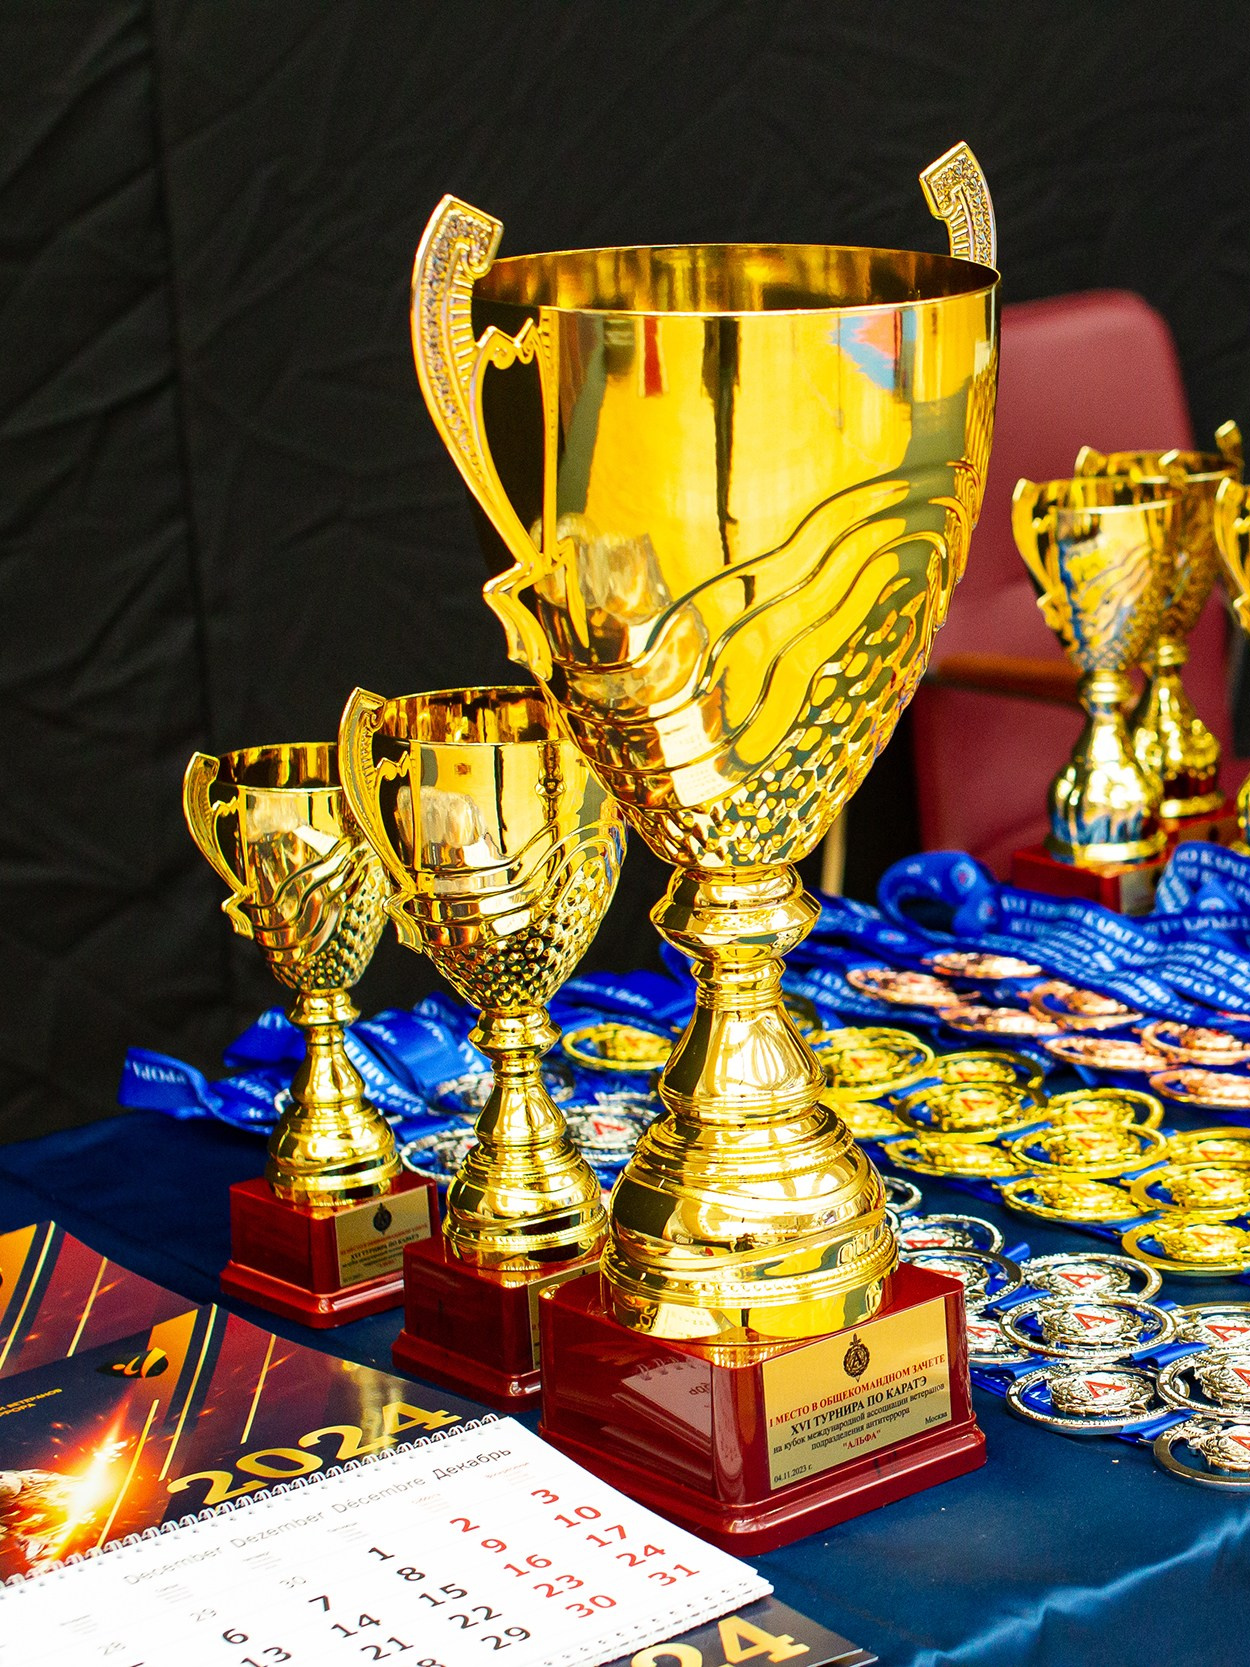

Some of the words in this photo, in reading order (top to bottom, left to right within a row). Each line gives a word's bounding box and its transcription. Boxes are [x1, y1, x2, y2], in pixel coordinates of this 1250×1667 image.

[775, 1405, 810, 1426] МЕСТО
[812, 1402, 818, 1412] В
[819, 1367, 910, 1409] ОБЩЕКОМАНДНОМ
[911, 1353, 946, 1375] ЗАЧЕТЕ
[784, 1436, 806, 1451] кубок
[807, 1412, 866, 1441] международной
[866, 1397, 909, 1419] ассоциации
[909, 1383, 945, 1402] ветеранов
[791, 1419, 811, 1436] XVI
[812, 1400, 865, 1428] ТУРНИРА
[867, 1392, 884, 1407] ПО
[886, 1375, 928, 1400] КАРАТЭ
[865, 1407, 910, 1430] антитеррора
[924, 1411, 948, 1425] Москва
[166, 1400, 463, 1506] 2024
[773, 1464, 807, 1483] 04.11.2023
[122, 1546, 223, 1586] December
[229, 1510, 326, 1549] Dezember
[331, 1477, 427, 1514] Décembre
[432, 1448, 512, 1481] Декабрь
[369, 1546, 396, 1561] 1
[449, 1517, 480, 1533] 2
[530, 1489, 560, 1505] 3
[221, 1628, 249, 1645] 6
[308, 1594, 331, 1612] 7
[396, 1566, 426, 1582] 8
[480, 1538, 508, 1554] 9
[553, 1505, 603, 1528] 10
[240, 1646, 292, 1667] 13
[330, 1612, 381, 1638] 14
[418, 1583, 468, 1608] 15
[503, 1553, 553, 1577] 16
[586, 1524, 628, 1548] 17
[359, 1635, 415, 1661] 21
[448, 1605, 503, 1630] 22
[533, 1574, 585, 1598] 23
[615, 1543, 667, 1568] 24
[480, 1626, 532, 1651] 29
[564, 1595, 617, 1618] 30
[647, 1563, 700, 1587] 31
